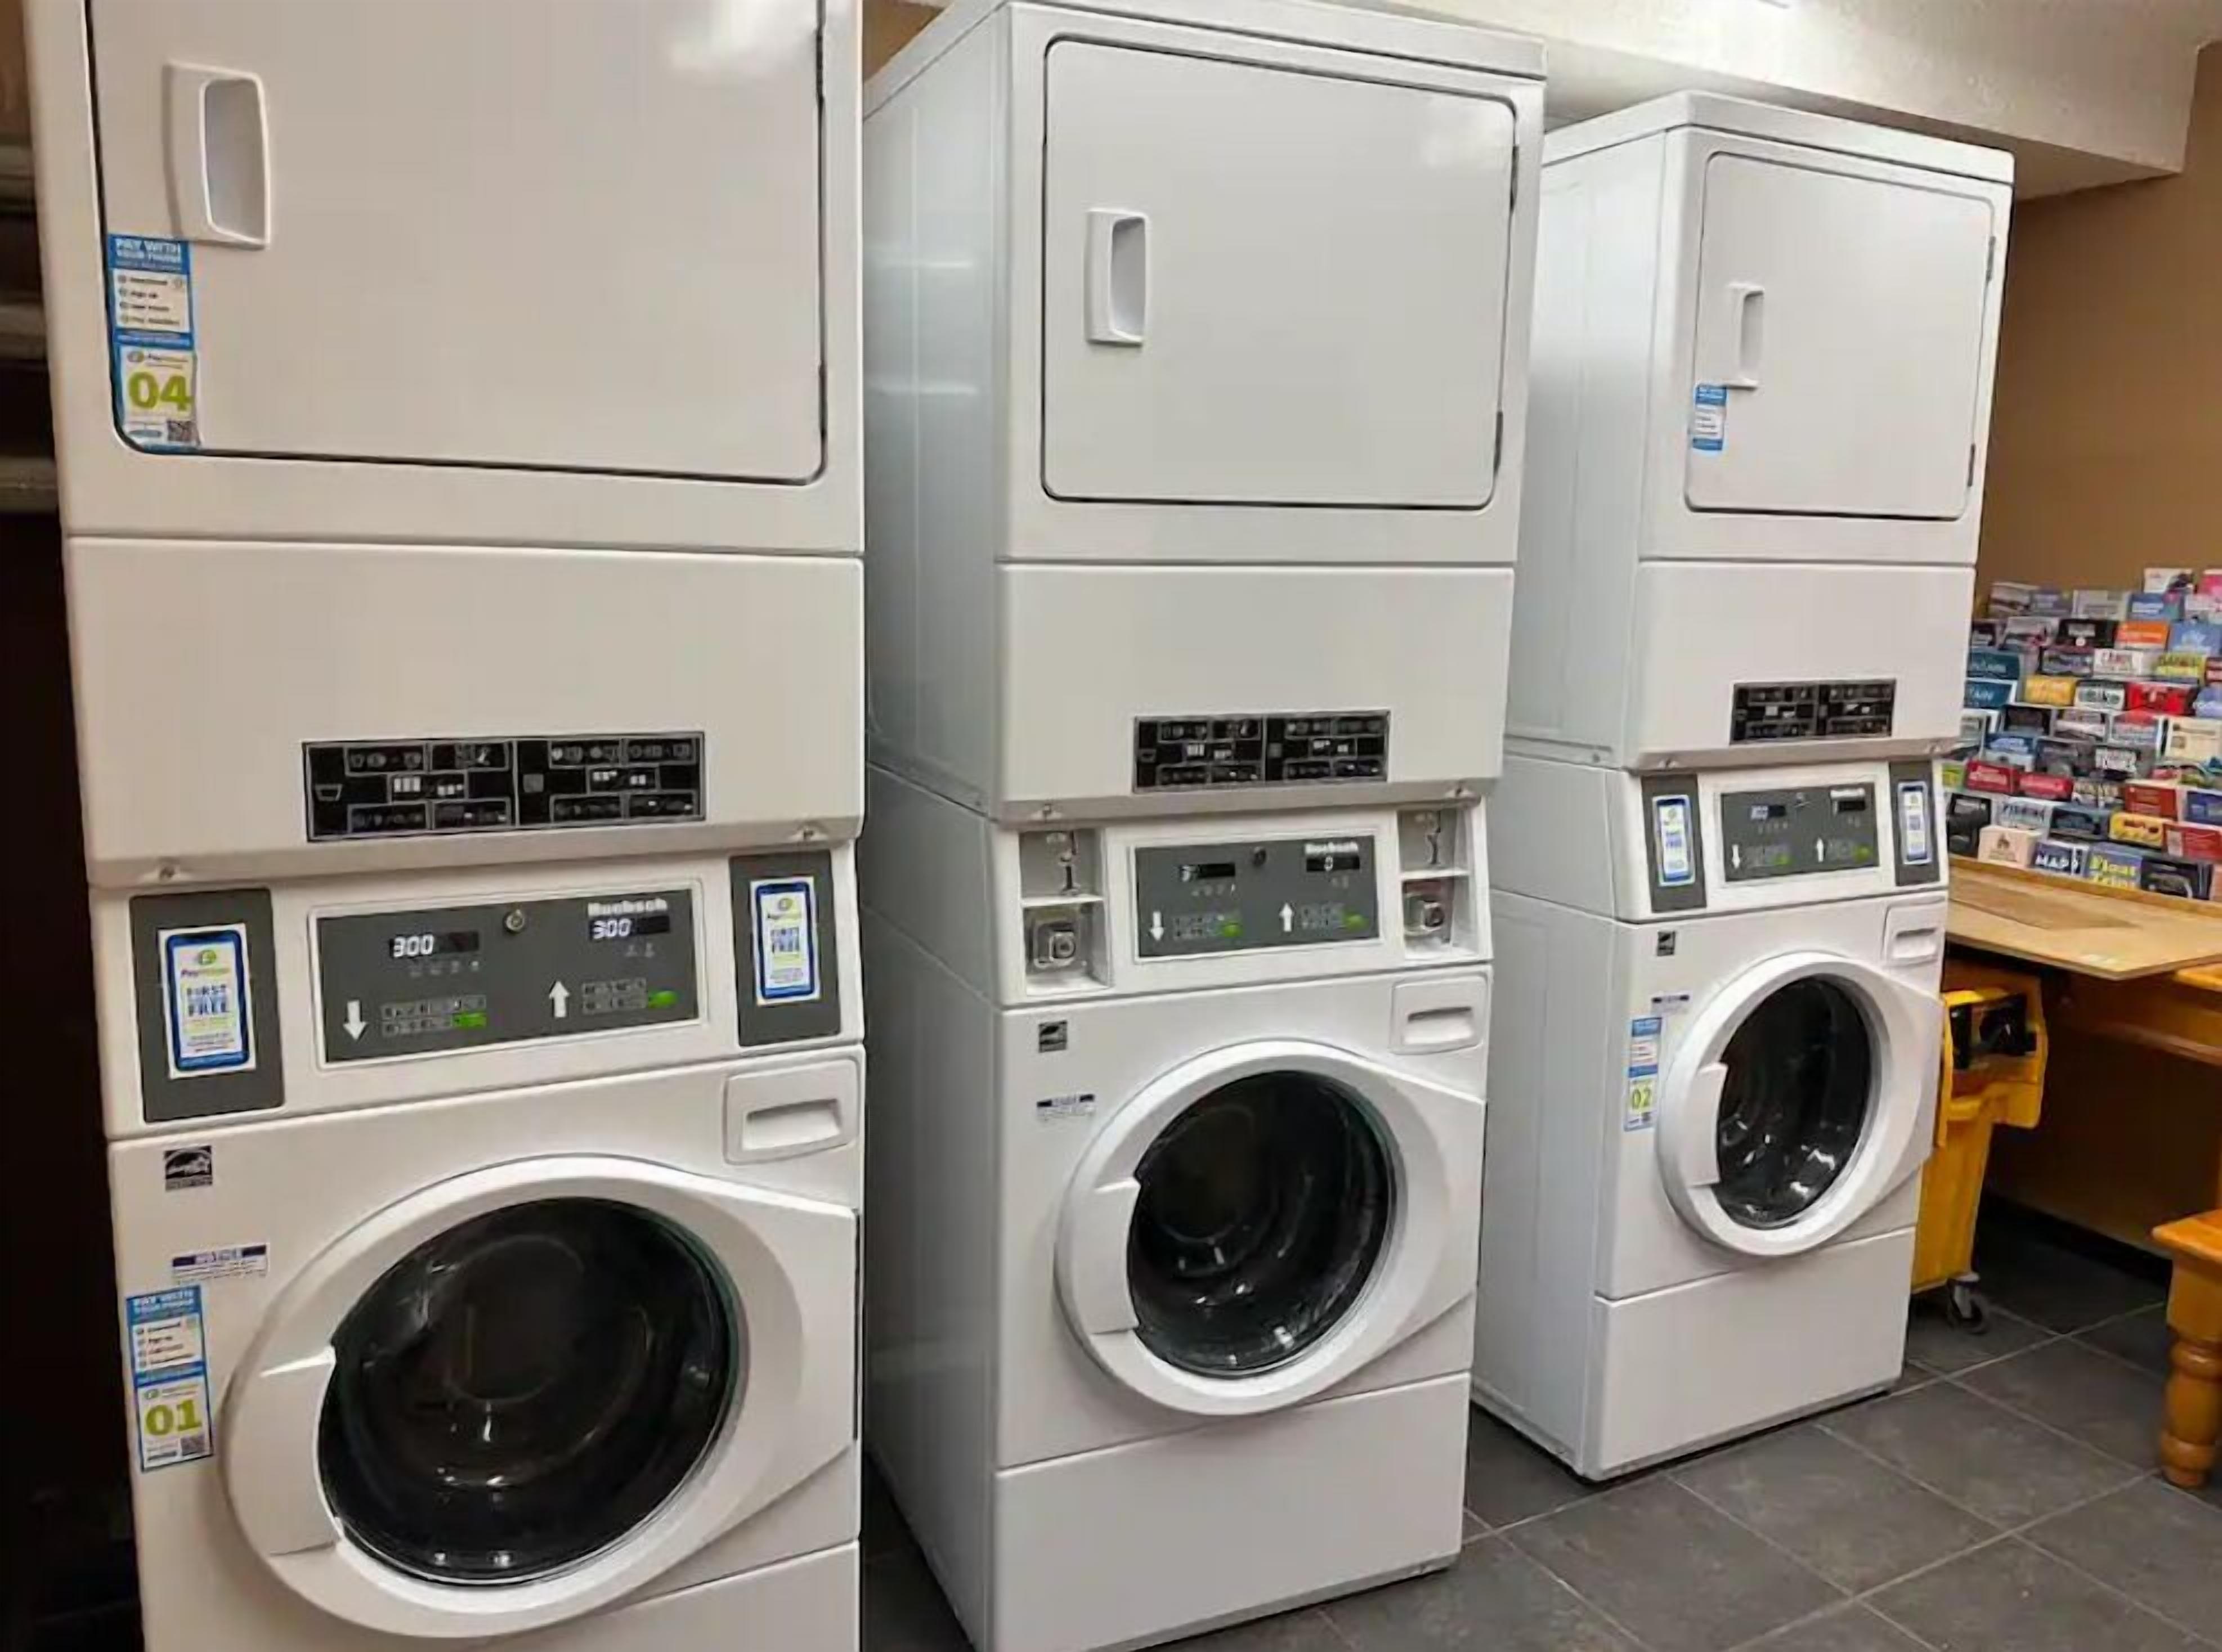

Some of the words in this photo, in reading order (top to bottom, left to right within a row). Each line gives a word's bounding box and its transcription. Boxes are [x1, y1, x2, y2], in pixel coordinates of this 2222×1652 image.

[129, 371, 193, 411] 04
[593, 917, 631, 940] 300
[393, 935, 434, 958] 300
[1631, 1087, 1652, 1110] 02
[146, 1399, 203, 1436] 01
